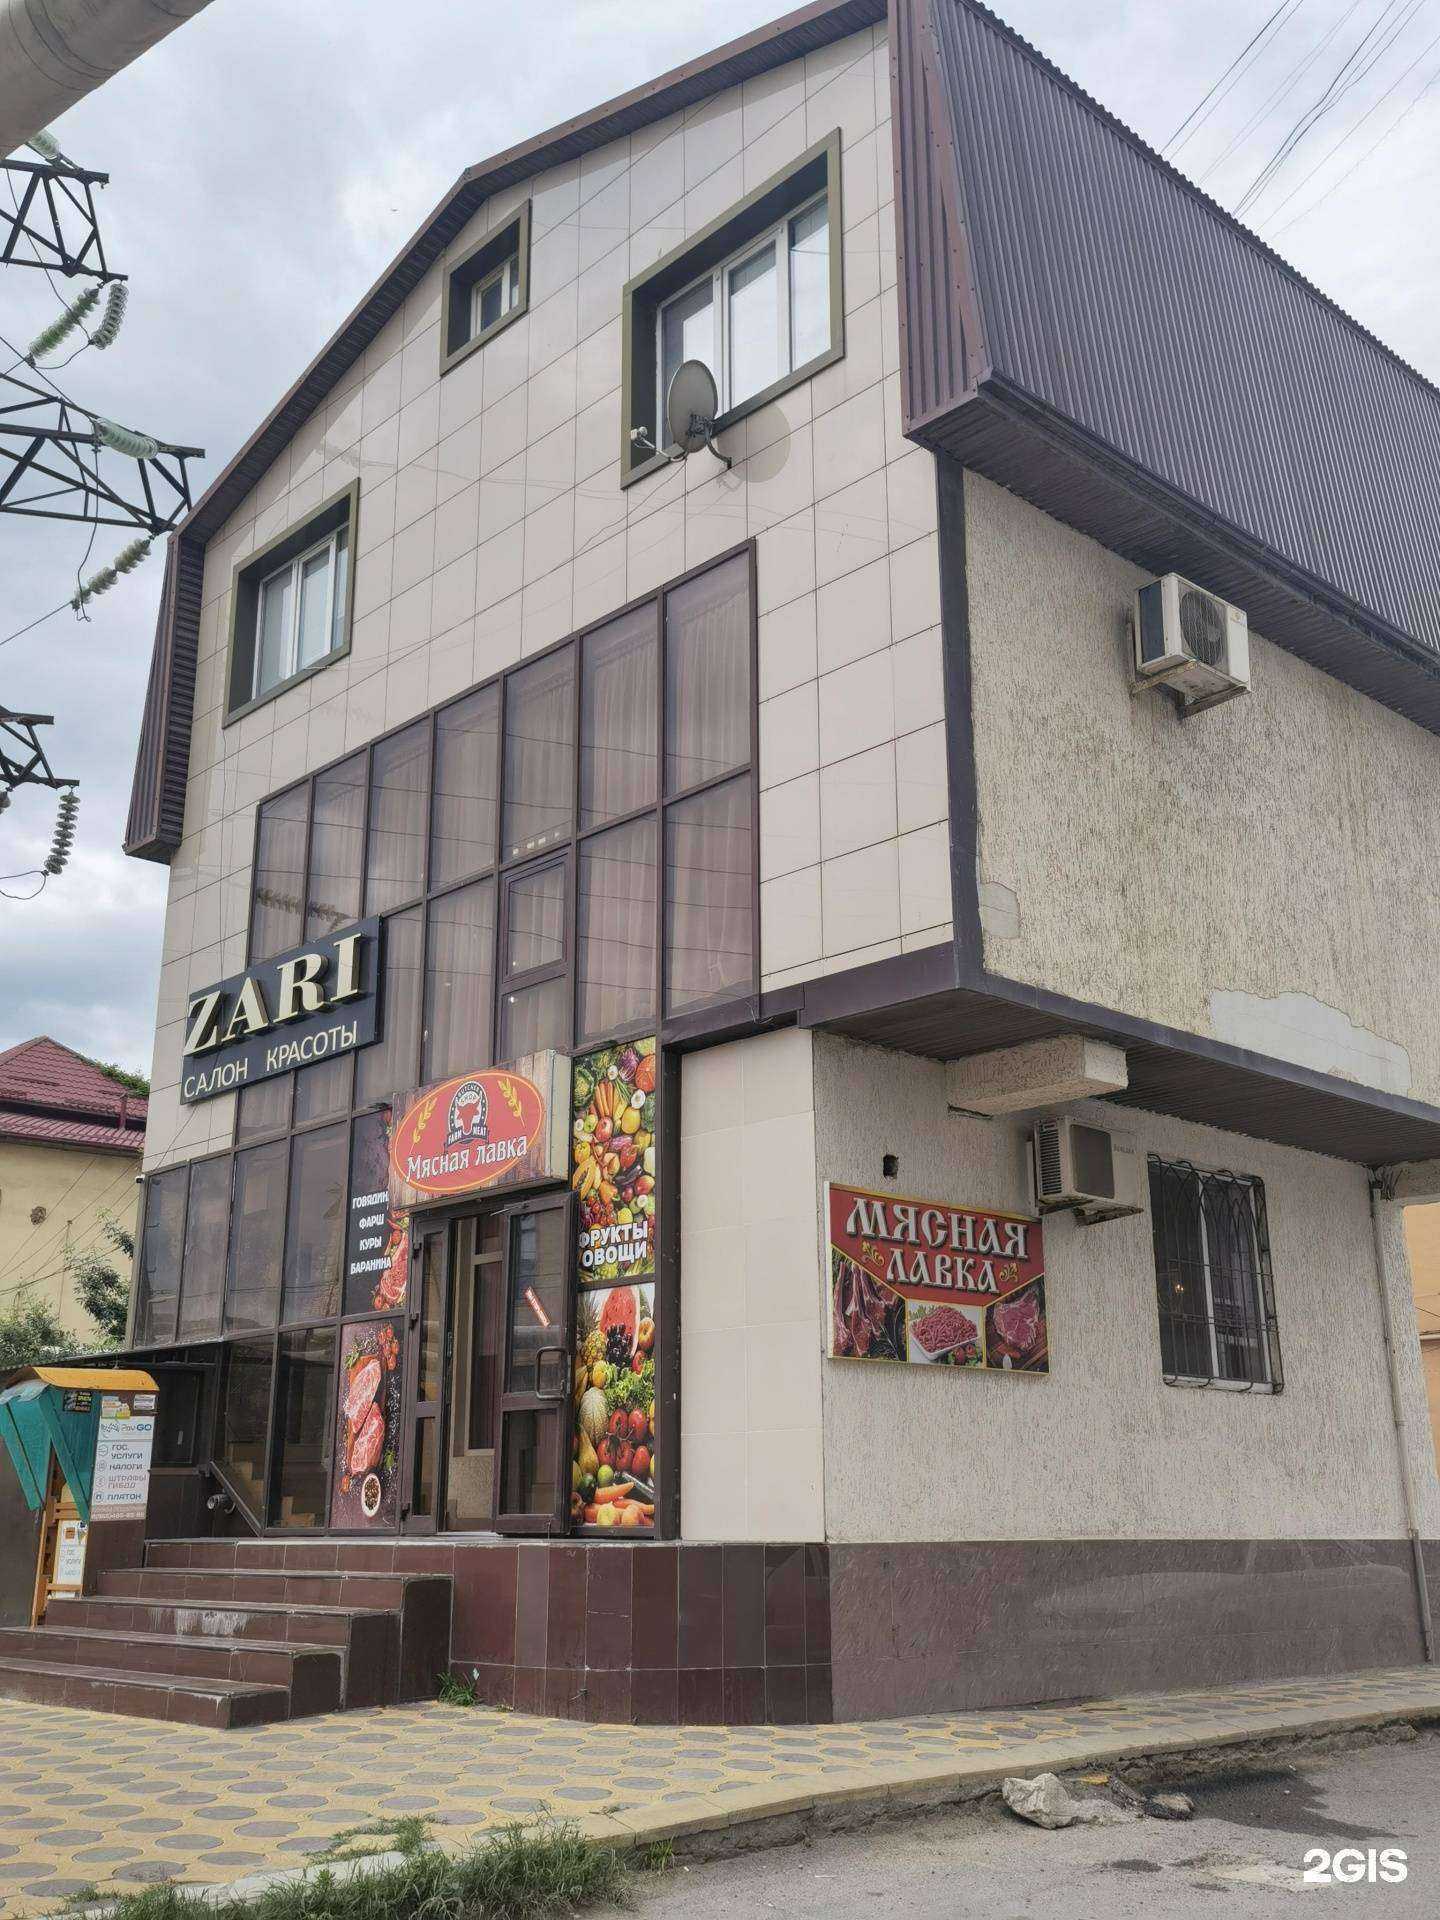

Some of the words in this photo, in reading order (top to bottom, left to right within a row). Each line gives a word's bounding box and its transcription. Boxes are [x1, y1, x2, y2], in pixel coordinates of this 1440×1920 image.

[184, 933, 362, 1055] ZARI
[184, 1057, 248, 1098] САЛОН
[266, 1021, 358, 1072] КРАСОТЫ
[448, 1130, 462, 1145] FARM
[472, 1126, 487, 1136] MEAT
[406, 1149, 470, 1182] Мясная
[475, 1135, 528, 1166] лавка
[352, 1191, 390, 1209] ГОВЯДИН
[359, 1213, 385, 1229] ФАРШ
[846, 1197, 1029, 1259] МЯСНАЯ
[360, 1236, 382, 1251] КУРЫ
[582, 1241, 647, 1267] ОВОЩИ
[350, 1257, 392, 1275] БАРАНИНА
[886, 1247, 1000, 1294] ЛАВКА
[111, 1452, 143, 1460] УСЛУГИ
[108, 1474, 147, 1482] ШТРАФЫ
[107, 1493, 142, 1501] ПЛАТОН
